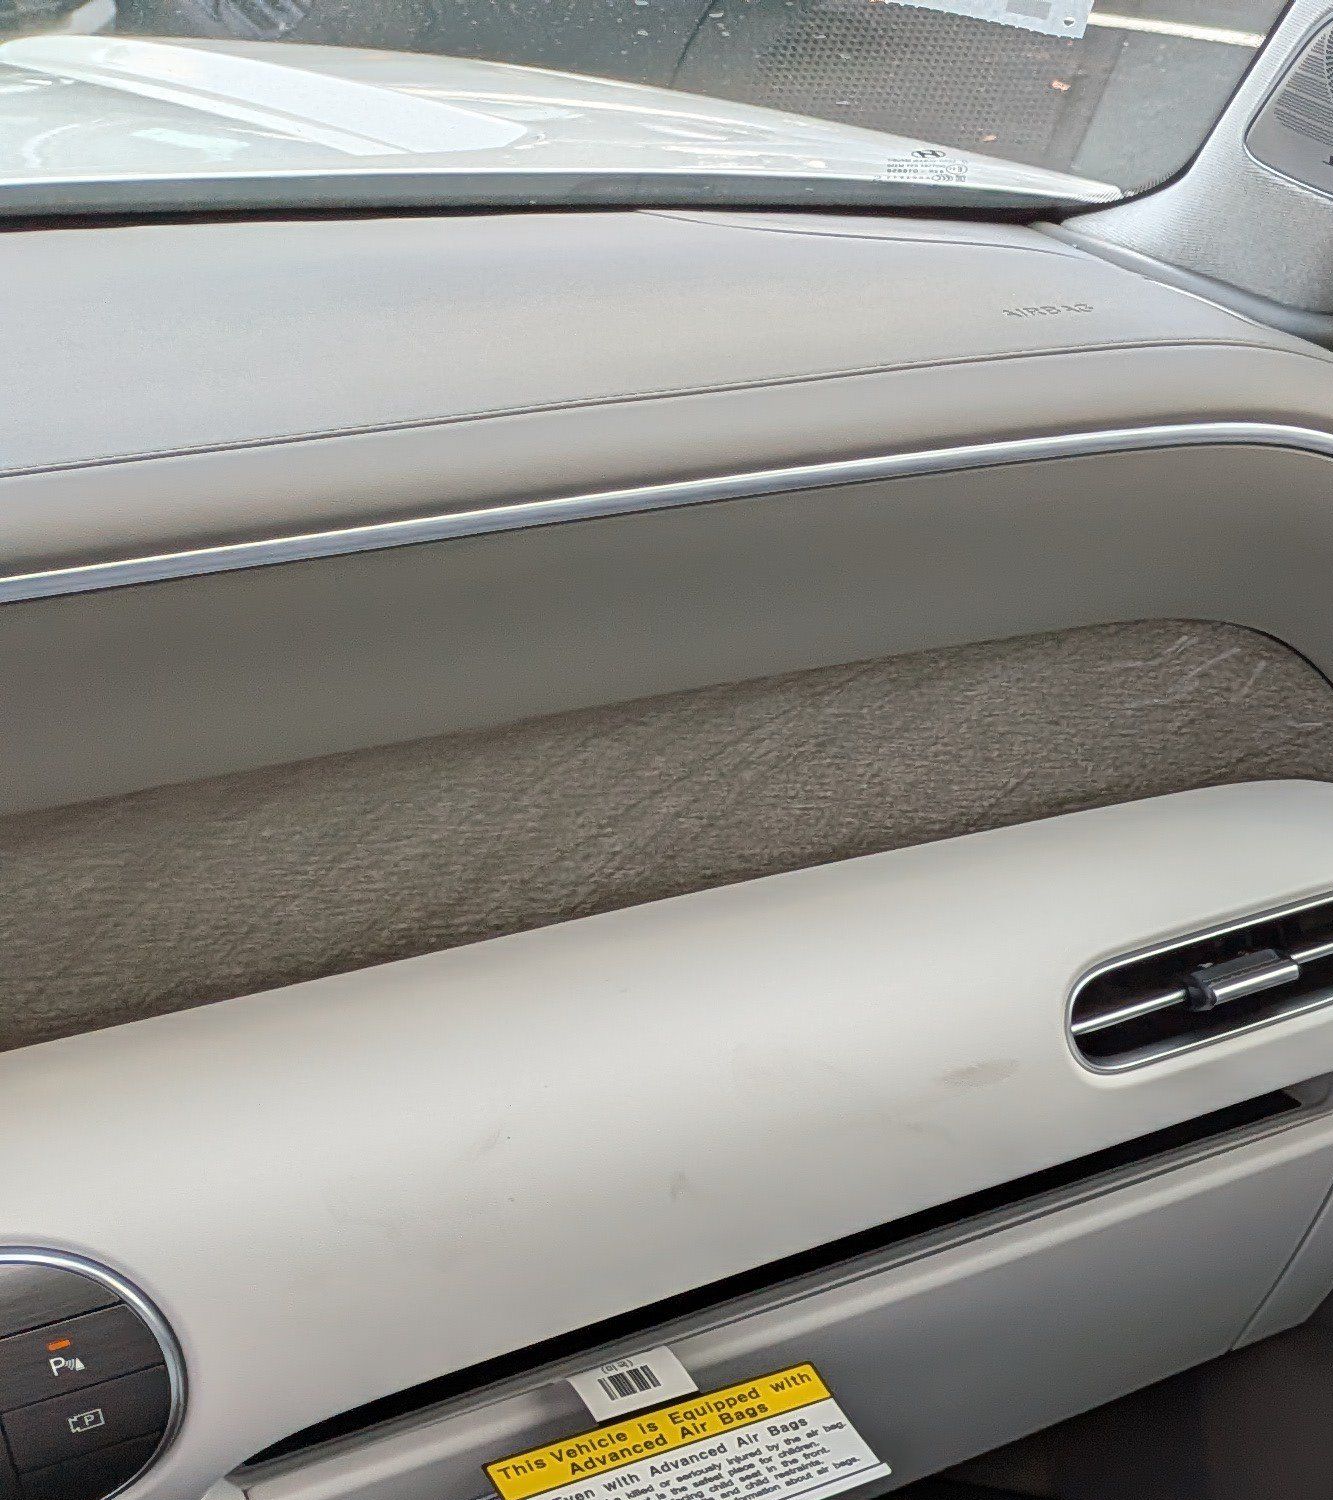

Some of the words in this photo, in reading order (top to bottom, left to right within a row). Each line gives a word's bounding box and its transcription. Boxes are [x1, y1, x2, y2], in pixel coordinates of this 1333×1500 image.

[497, 1457, 547, 1479] This
[550, 1429, 627, 1463] Vehicle
[638, 1422, 659, 1435] is
[668, 1387, 761, 1425] Equipped
[770, 1371, 812, 1393] with
[571, 1434, 668, 1476] Advanced
[680, 1420, 708, 1439] Air
[719, 1402, 769, 1426] Bags
[604, 1473, 641, 1492] with
[649, 1443, 728, 1477] Advanced
[737, 1433, 759, 1448] Air
[767, 1418, 808, 1437] Bags
[626, 1485, 654, 1500] killed
[659, 1480, 671, 1488] or
[675, 1461, 722, 1482] seriously
[726, 1448, 762, 1465] injured
[765, 1443, 780, 1452] by
[784, 1436, 801, 1446] the
[806, 1429, 819, 1438] air
[655, 1492, 667, 1500] is
[670, 1485, 688, 1495] the
[692, 1472, 723, 1488] safest
[728, 1462, 755, 1477] place
[759, 1456, 773, 1464] for
[708, 1480, 734, 1493] child
[738, 1470, 763, 1483] seat
[765, 1465, 777, 1473] in
[781, 1458, 799, 1468] the
[785, 1472, 813, 1487] about
[816, 1466, 829, 1475] air
[720, 1487, 740, 1499] and
[745, 1477, 769, 1490] child
